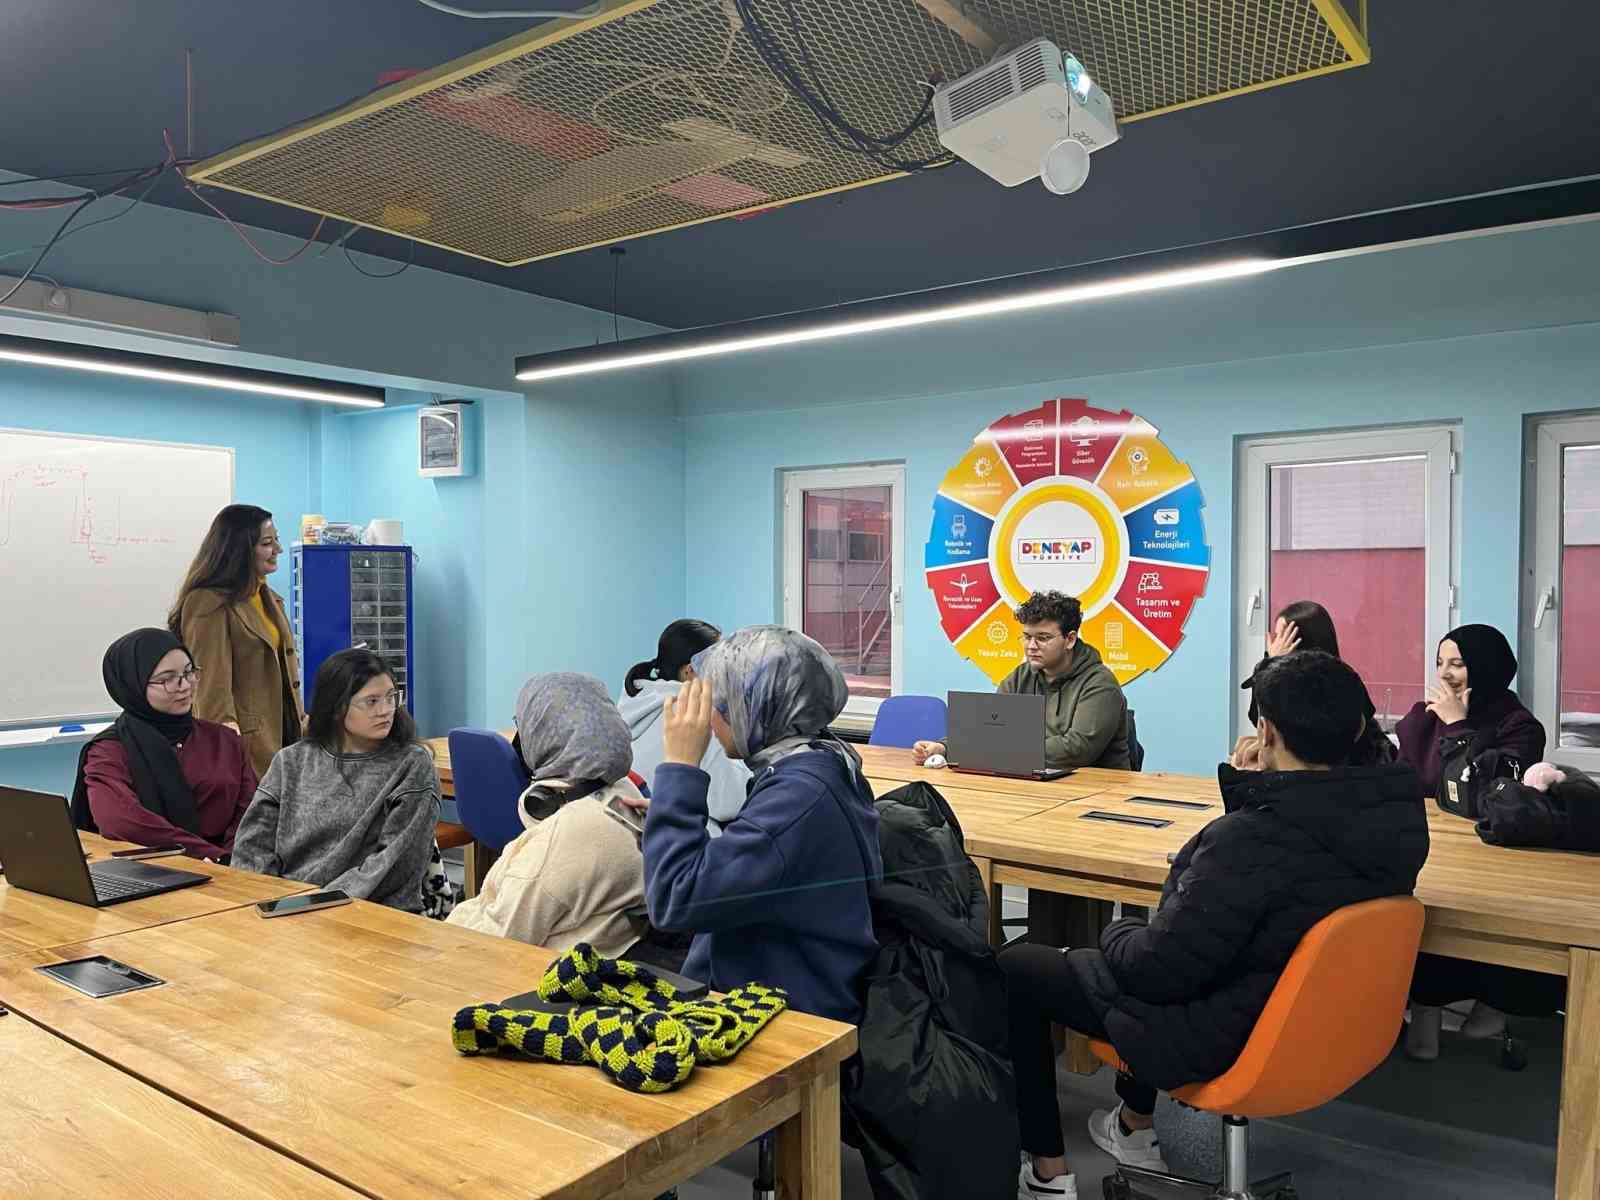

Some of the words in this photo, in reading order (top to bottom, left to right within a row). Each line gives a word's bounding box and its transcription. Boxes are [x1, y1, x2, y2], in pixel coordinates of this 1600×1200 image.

[1154, 529, 1179, 539] Enerji
[1021, 541, 1093, 555] DENEYAP
[1143, 540, 1191, 551] Teknolojileri
[1136, 597, 1169, 608] Tasarım
[1170, 598, 1181, 607] ve
[1143, 607, 1173, 619] Üretim
